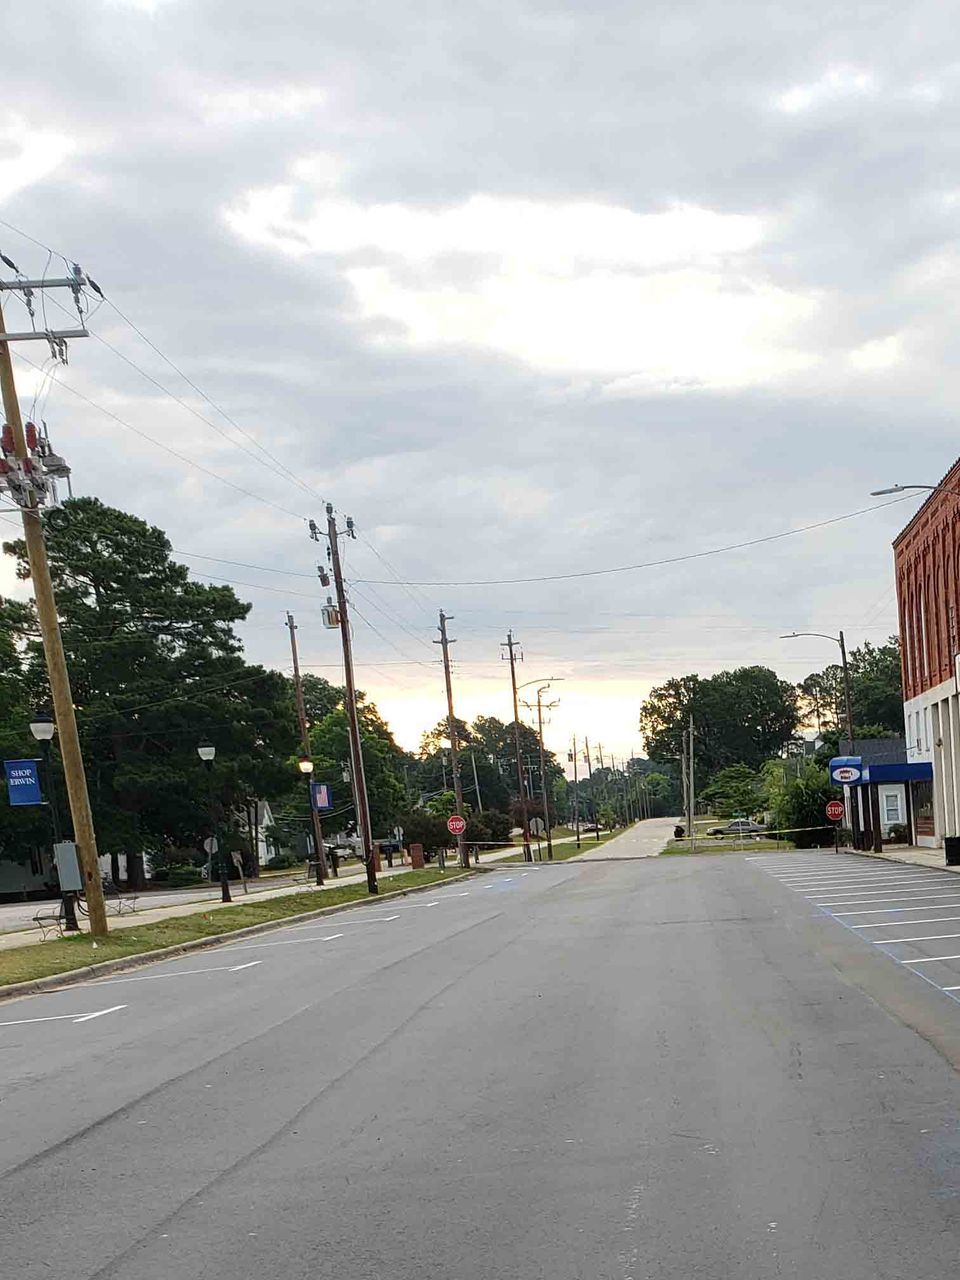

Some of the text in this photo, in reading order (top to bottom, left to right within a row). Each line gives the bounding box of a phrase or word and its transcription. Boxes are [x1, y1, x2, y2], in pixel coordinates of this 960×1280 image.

[11, 769, 32, 777] SHOP
[10, 777, 36, 786] ERWIN
[827, 806, 843, 815] STOP
[449, 821, 464, 829] STOP
